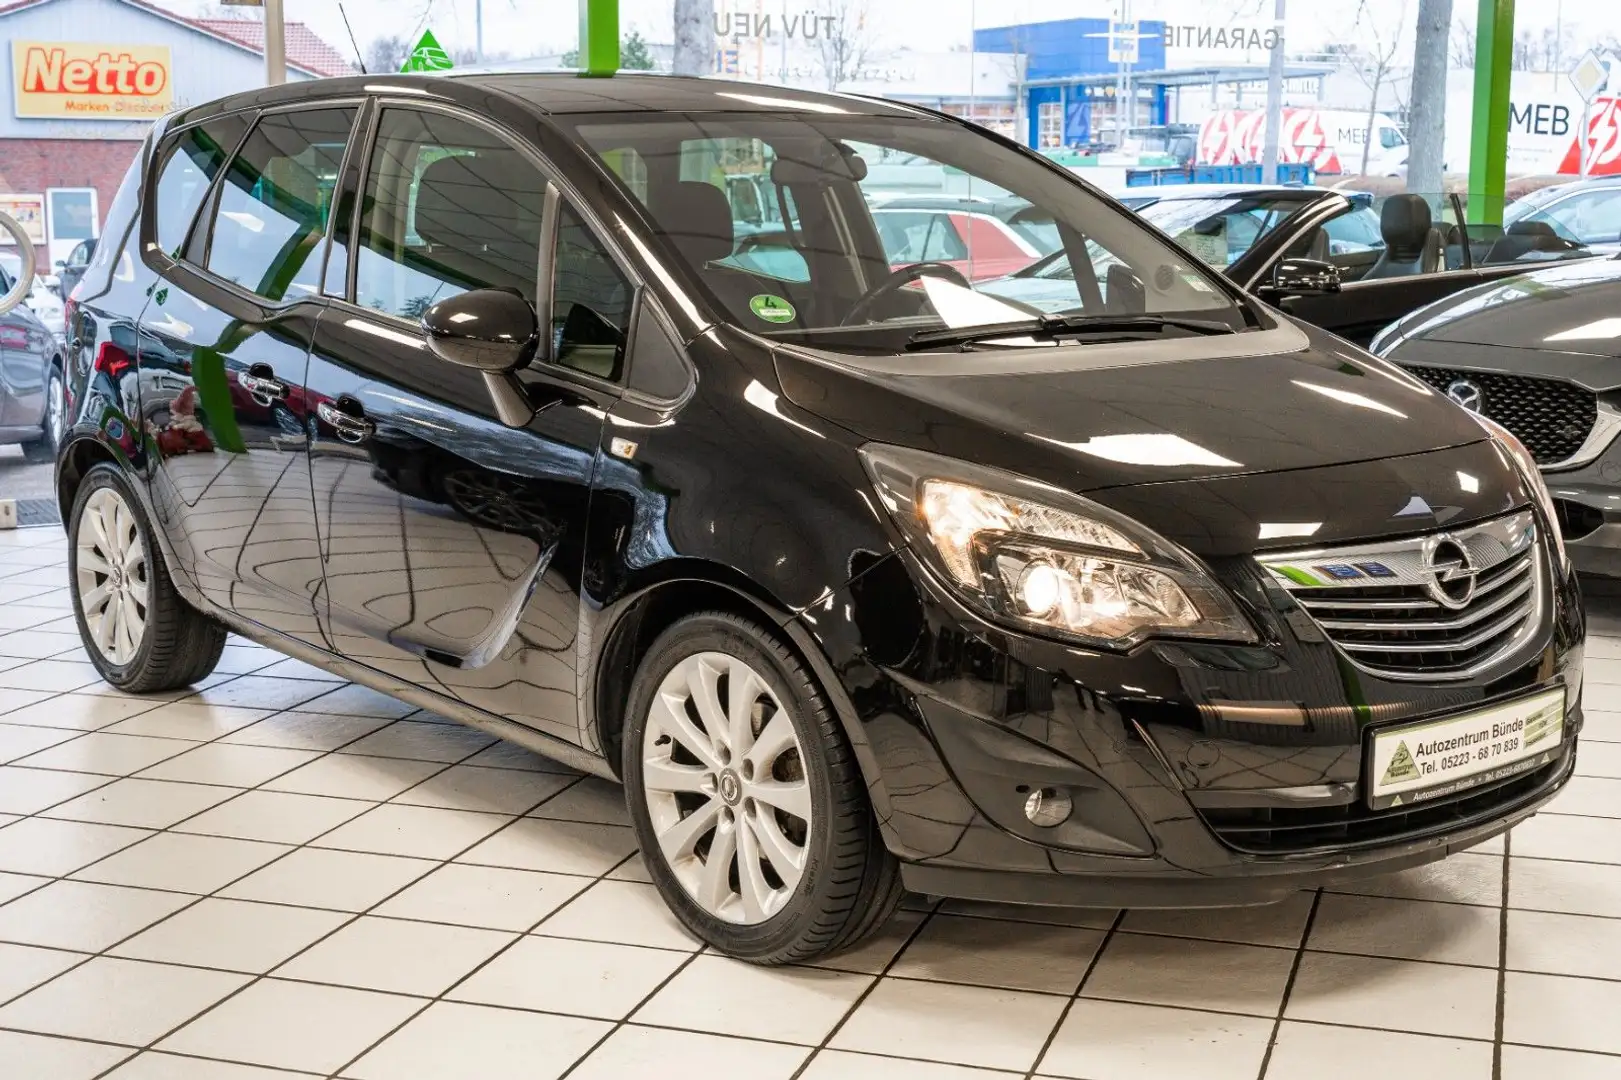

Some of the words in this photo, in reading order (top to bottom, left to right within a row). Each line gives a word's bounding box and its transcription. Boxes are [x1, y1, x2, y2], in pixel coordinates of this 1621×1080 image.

[23, 47, 166, 96] Netto
[65, 100, 109, 112] Marken
[1508, 103, 1570, 135] MEB
[1416, 729, 1489, 758] Autozentrum
[1492, 717, 1524, 739] Bünde
[1420, 760, 1438, 775] Tel.
[1441, 752, 1470, 770] 05223
[1478, 746, 1489, 760] 68
[1492, 742, 1501, 757] 70
[1504, 737, 1519, 752] 839
